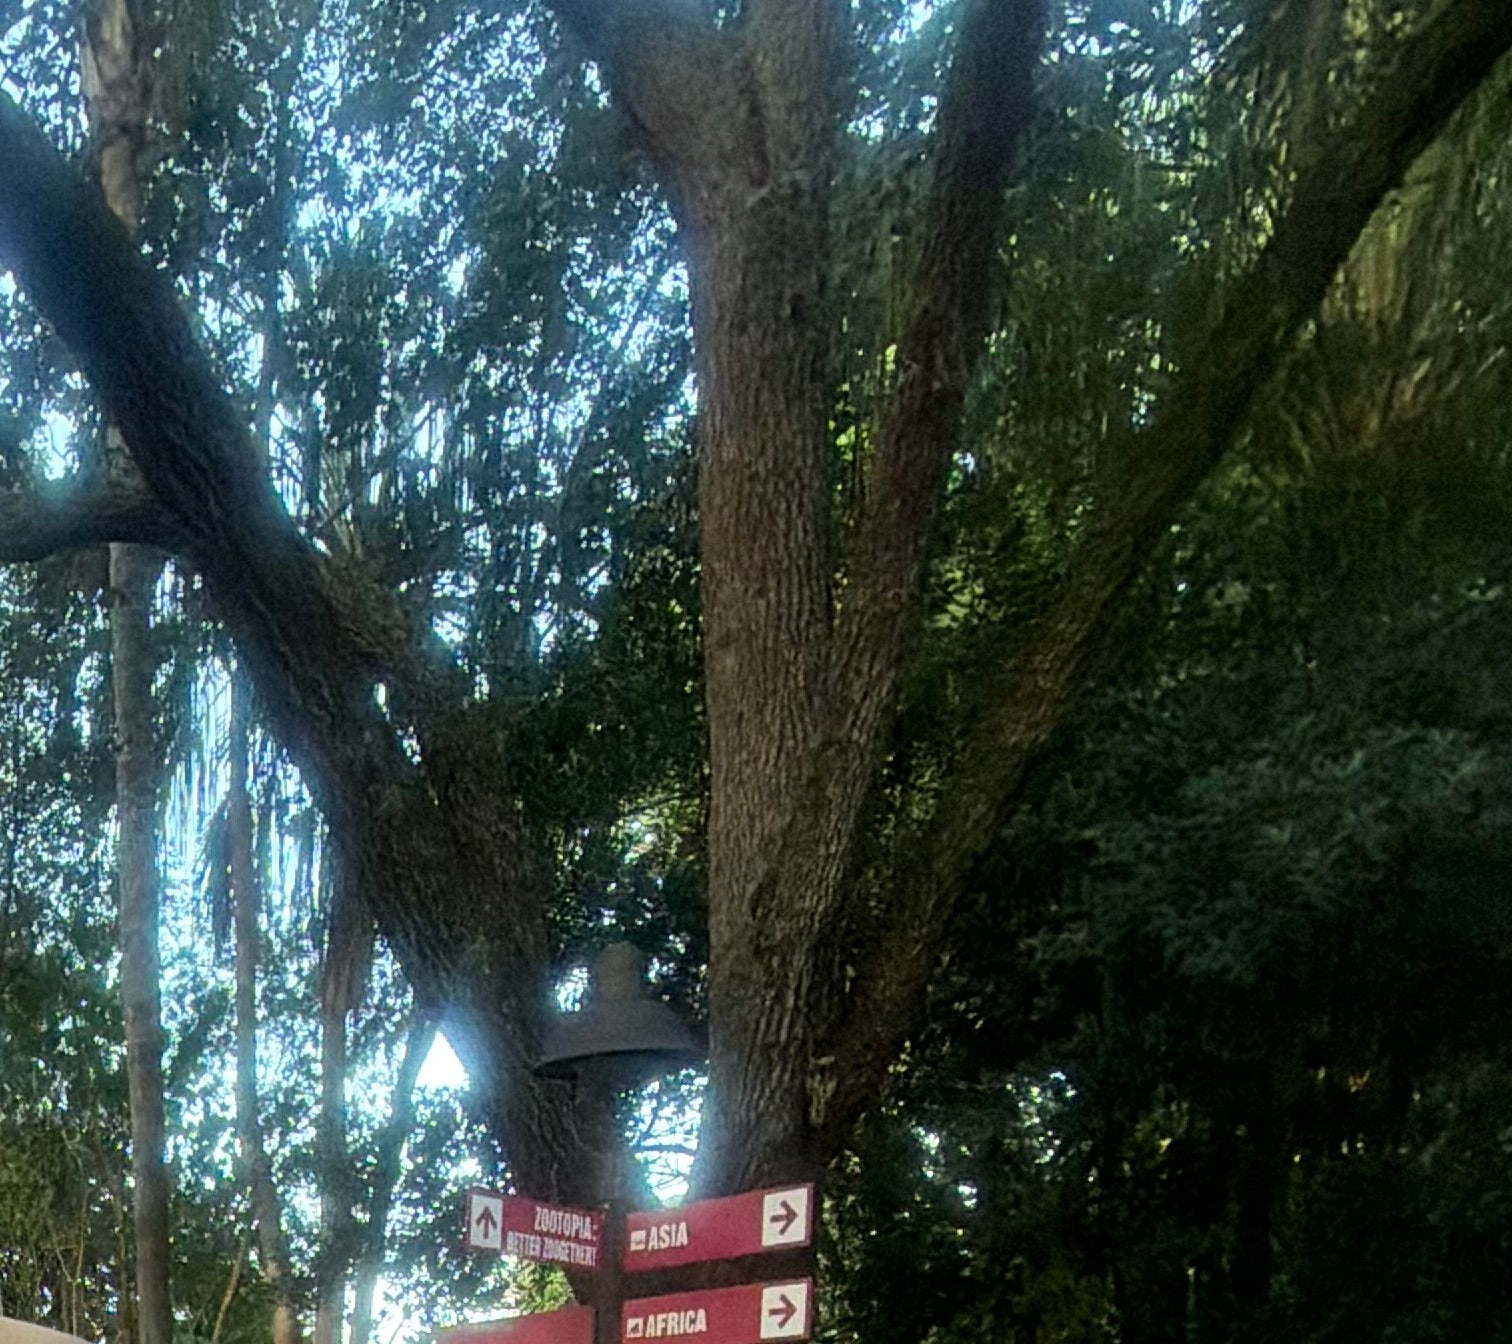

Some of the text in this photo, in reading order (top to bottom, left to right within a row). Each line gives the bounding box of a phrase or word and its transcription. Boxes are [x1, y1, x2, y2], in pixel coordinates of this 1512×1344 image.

[534, 1204, 598, 1241] ZOOTOPIA:
[648, 1222, 688, 1251] ASIA
[645, 1308, 707, 1337] AFRICA
